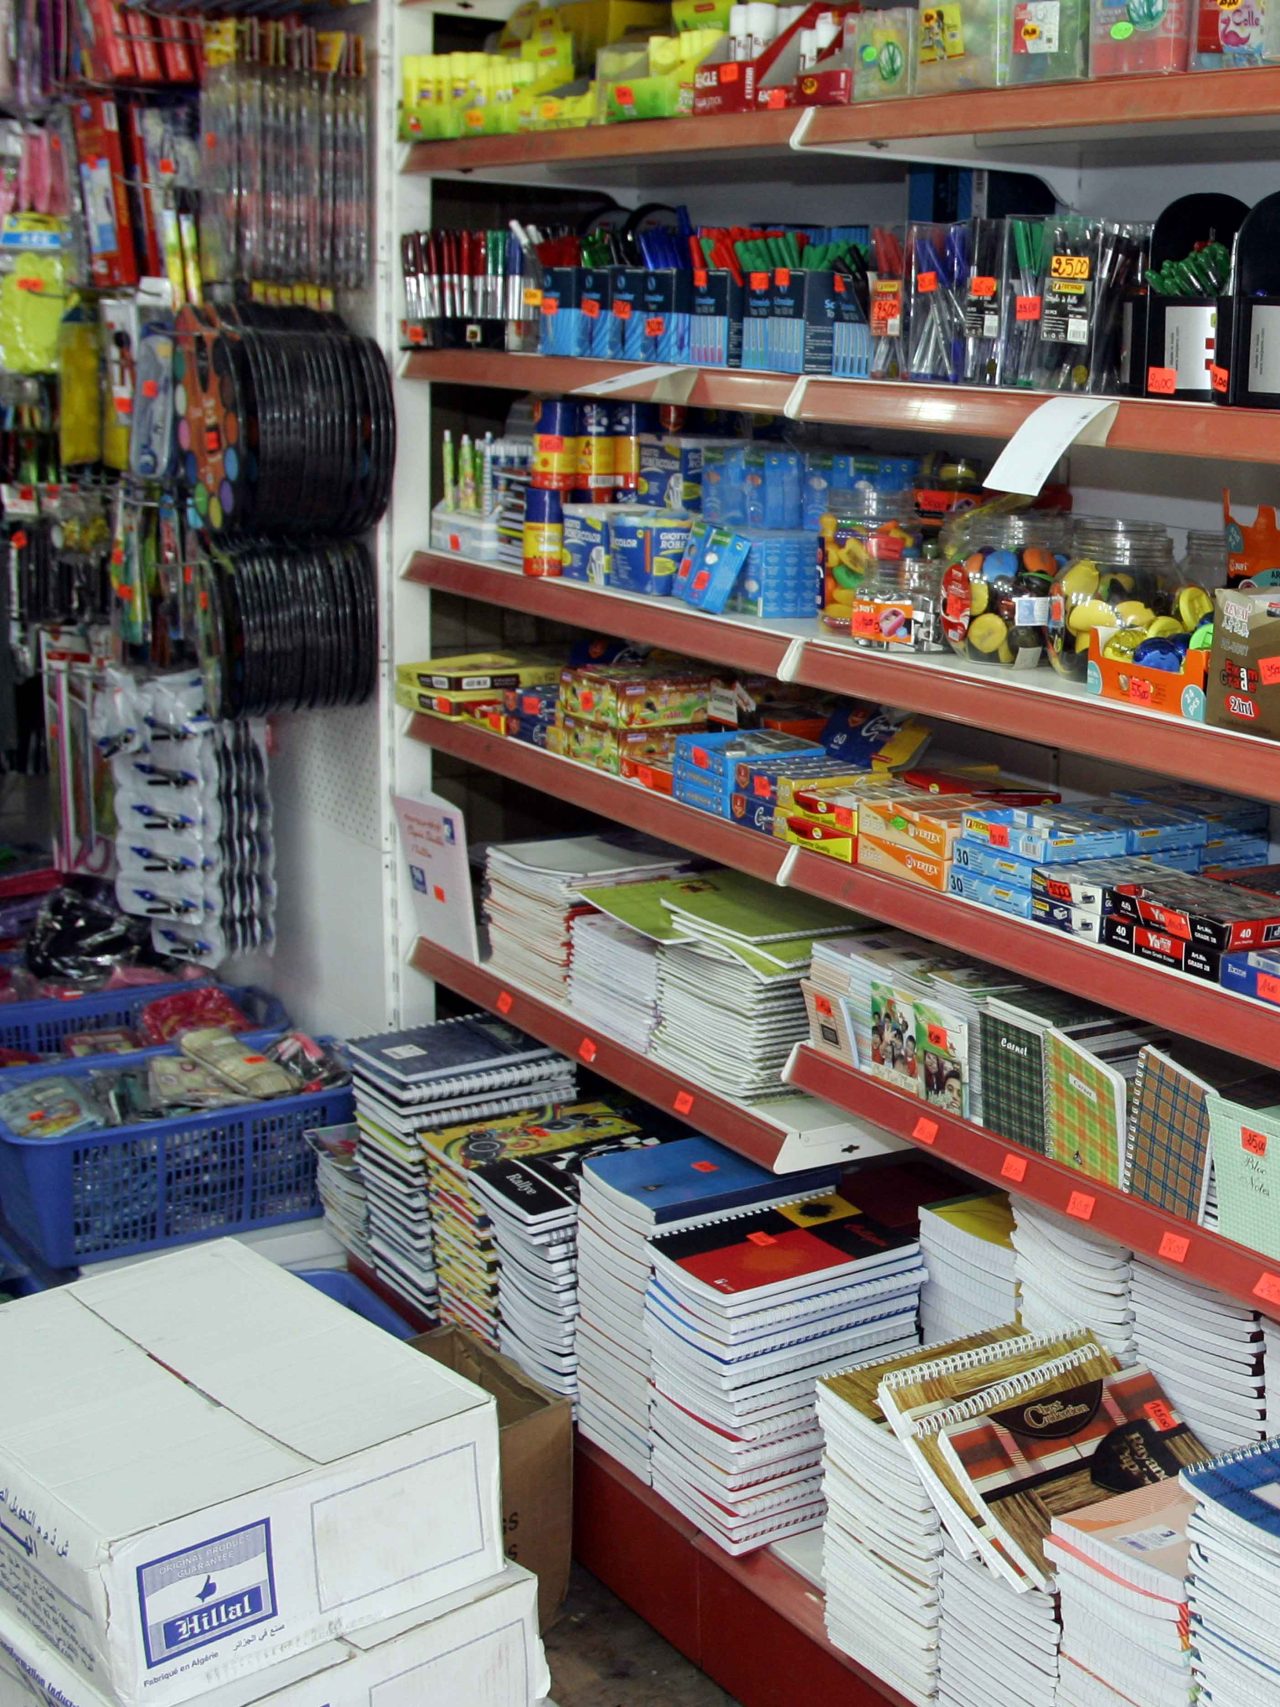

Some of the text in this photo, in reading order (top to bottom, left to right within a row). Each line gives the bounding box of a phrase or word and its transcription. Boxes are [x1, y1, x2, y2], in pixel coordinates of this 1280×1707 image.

[955, 847, 969, 866] 30
[949, 873, 964, 894] 30
[1240, 928, 1252, 939] 40
[174, 1594, 252, 1642] Hillal
[180, 1663, 191, 1673] en
[191, 1650, 220, 1669] Algérie
